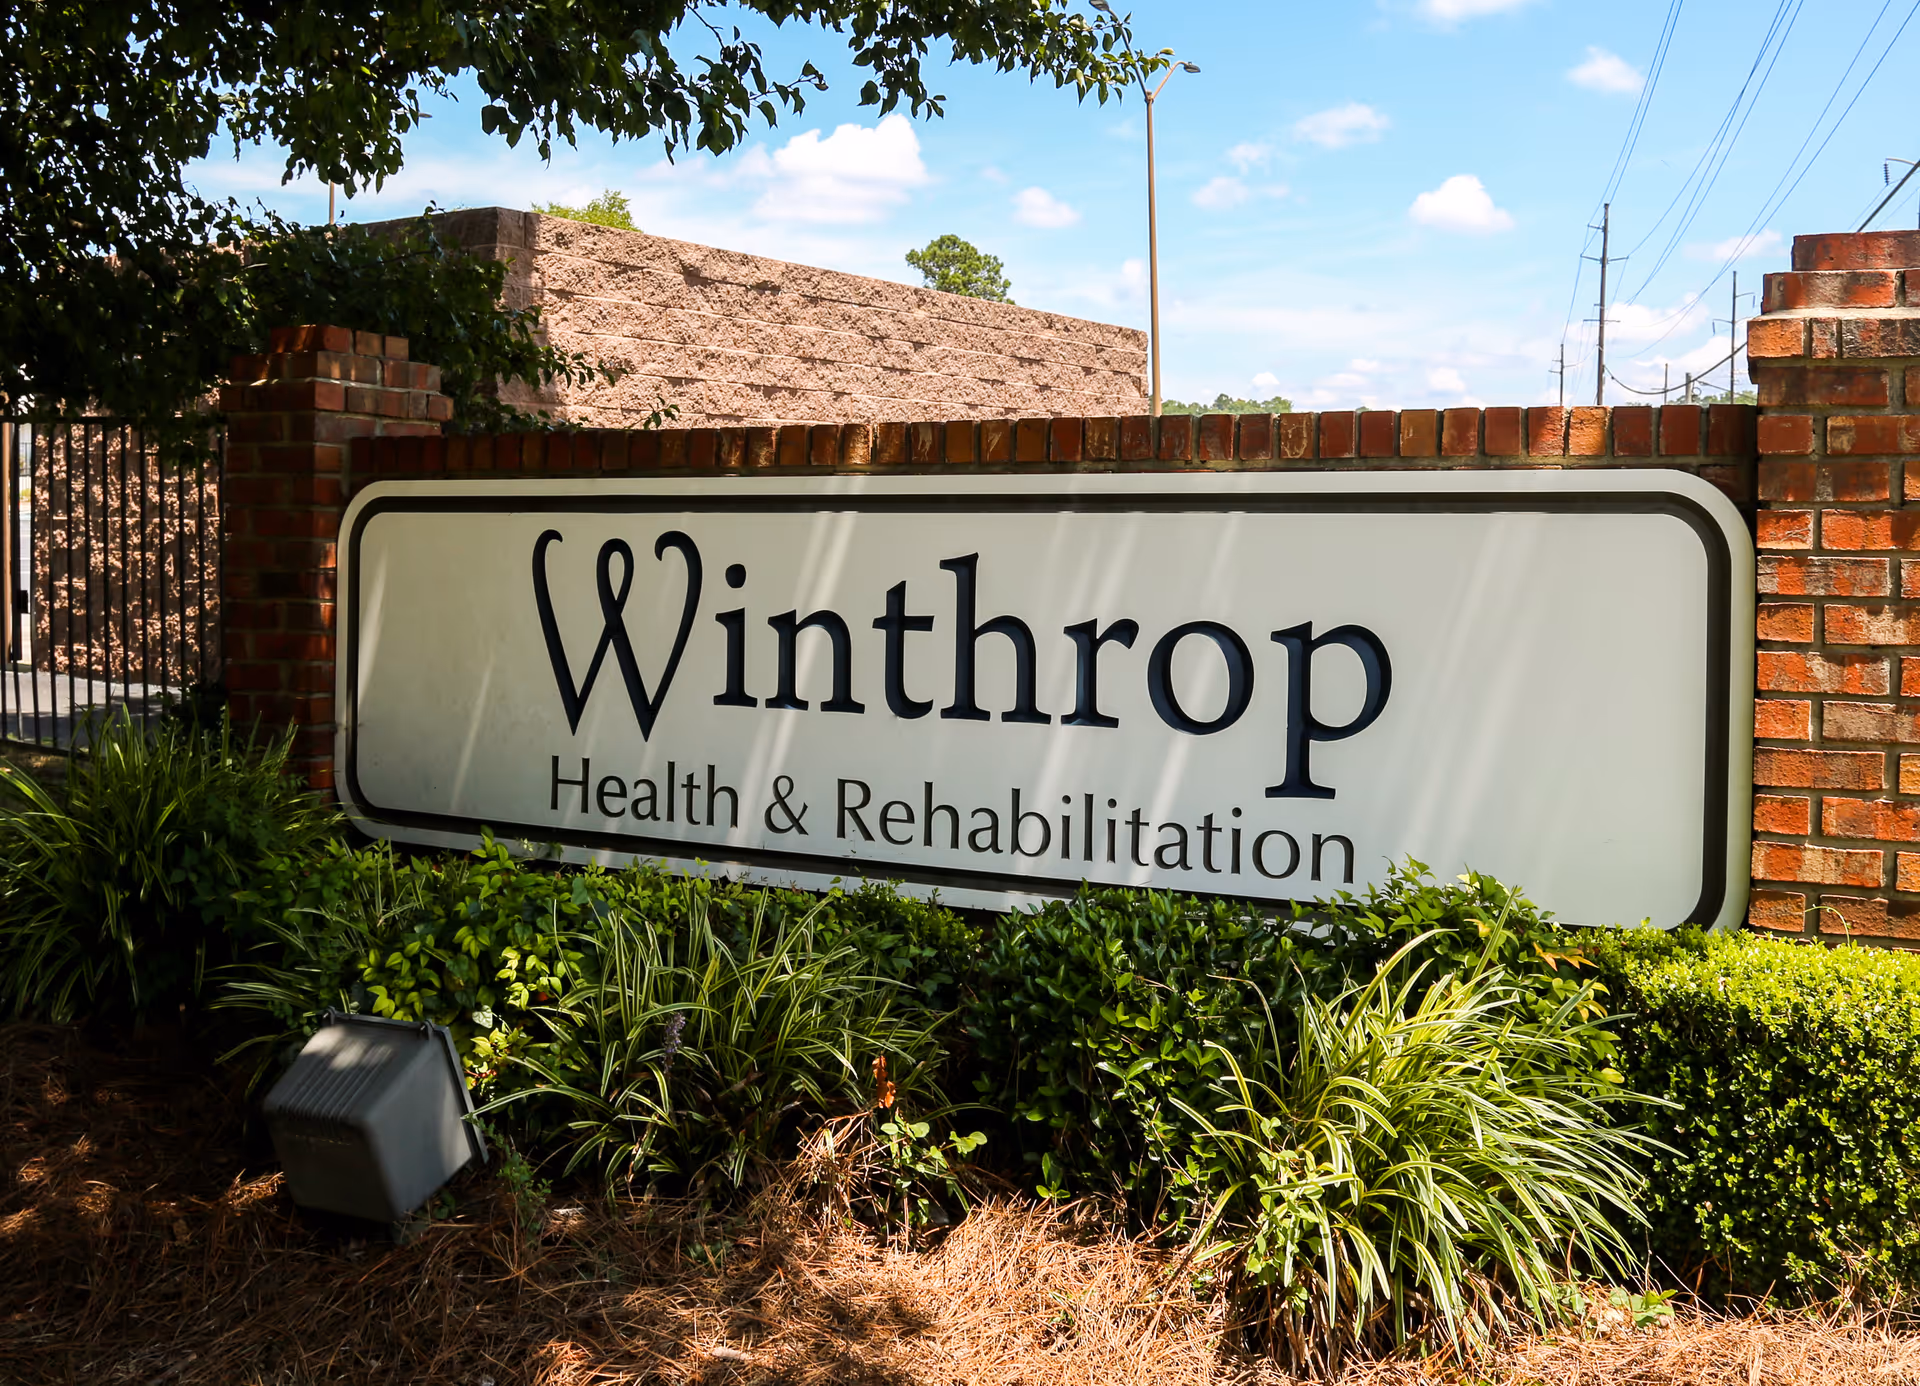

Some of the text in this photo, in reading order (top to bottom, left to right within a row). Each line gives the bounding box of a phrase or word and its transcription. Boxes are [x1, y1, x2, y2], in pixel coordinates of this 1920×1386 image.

[532, 530, 1392, 799] Winthrop
[551, 755, 1355, 884] Health & Rehabilitation
